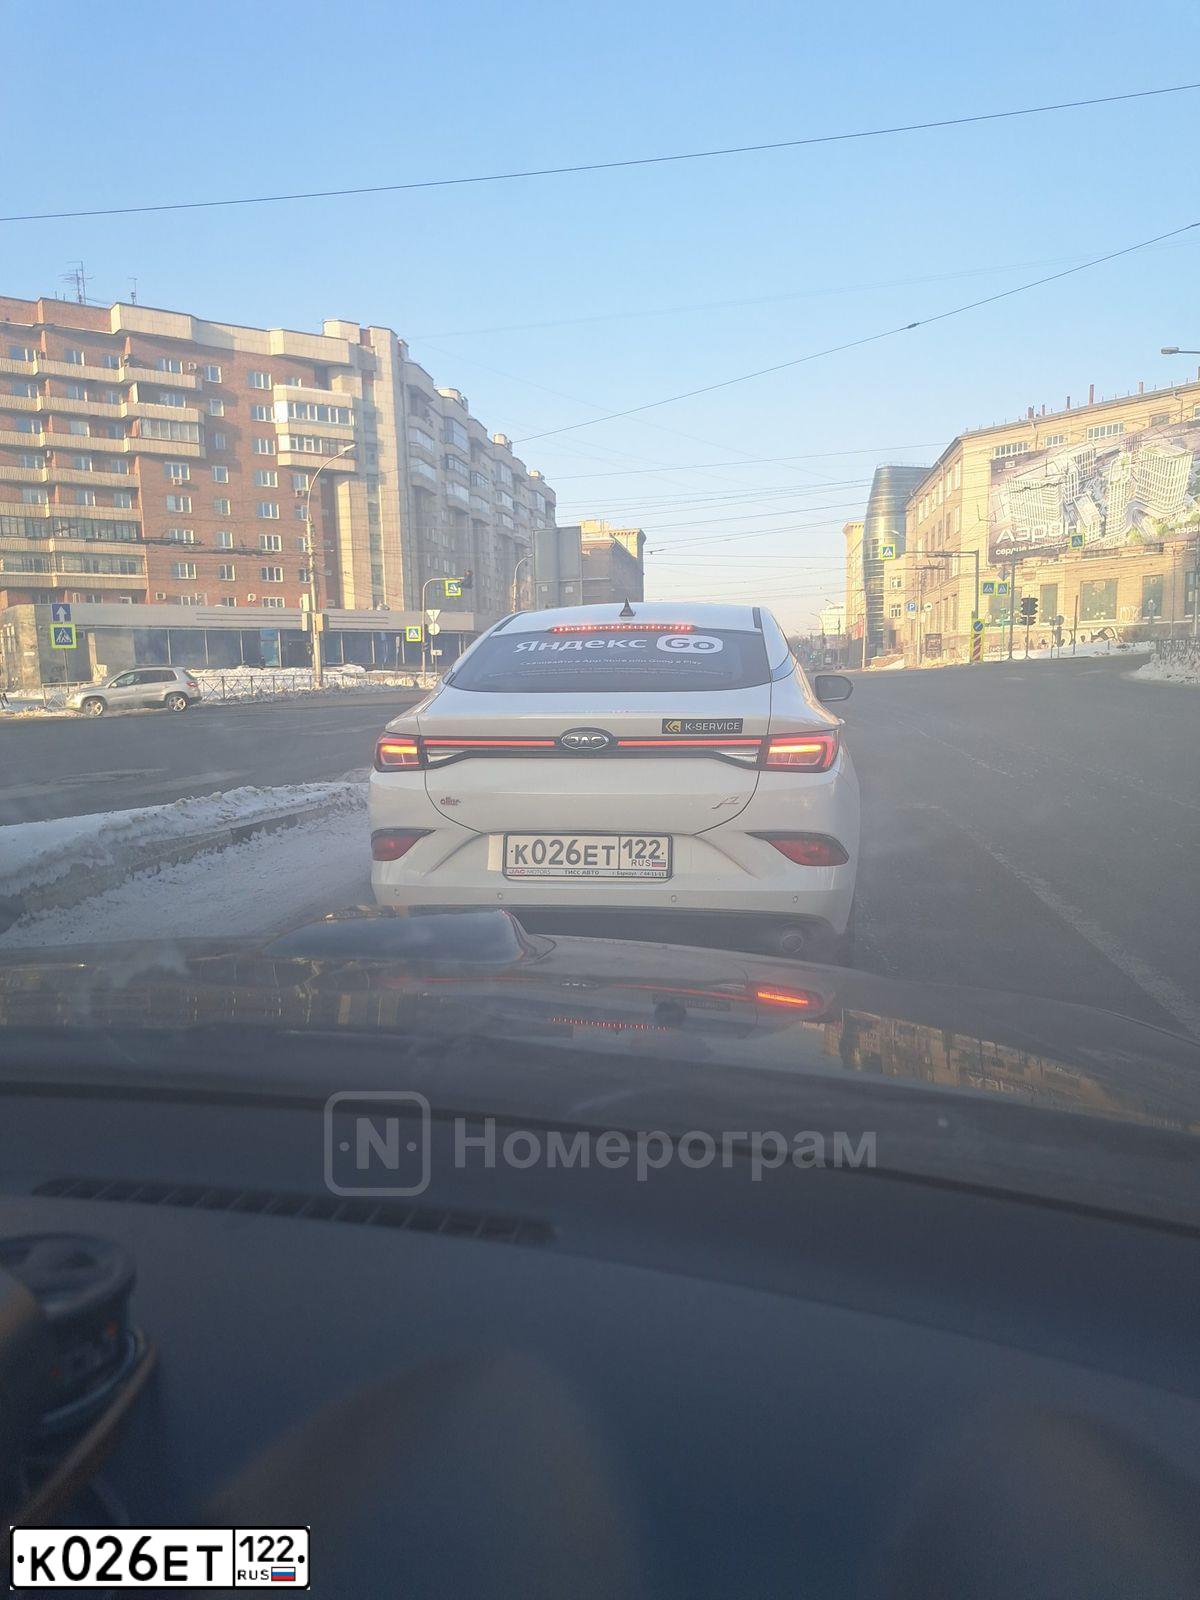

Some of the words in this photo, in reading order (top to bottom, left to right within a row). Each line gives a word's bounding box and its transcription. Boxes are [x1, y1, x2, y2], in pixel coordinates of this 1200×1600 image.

[512, 638, 648, 653] Яндекс
[662, 636, 718, 651] Go
[685, 722, 741, 731] K-SERVICE
[514, 838, 616, 866] К026ЕТ
[622, 839, 661, 859] 122
[631, 859, 651, 867] RUS
